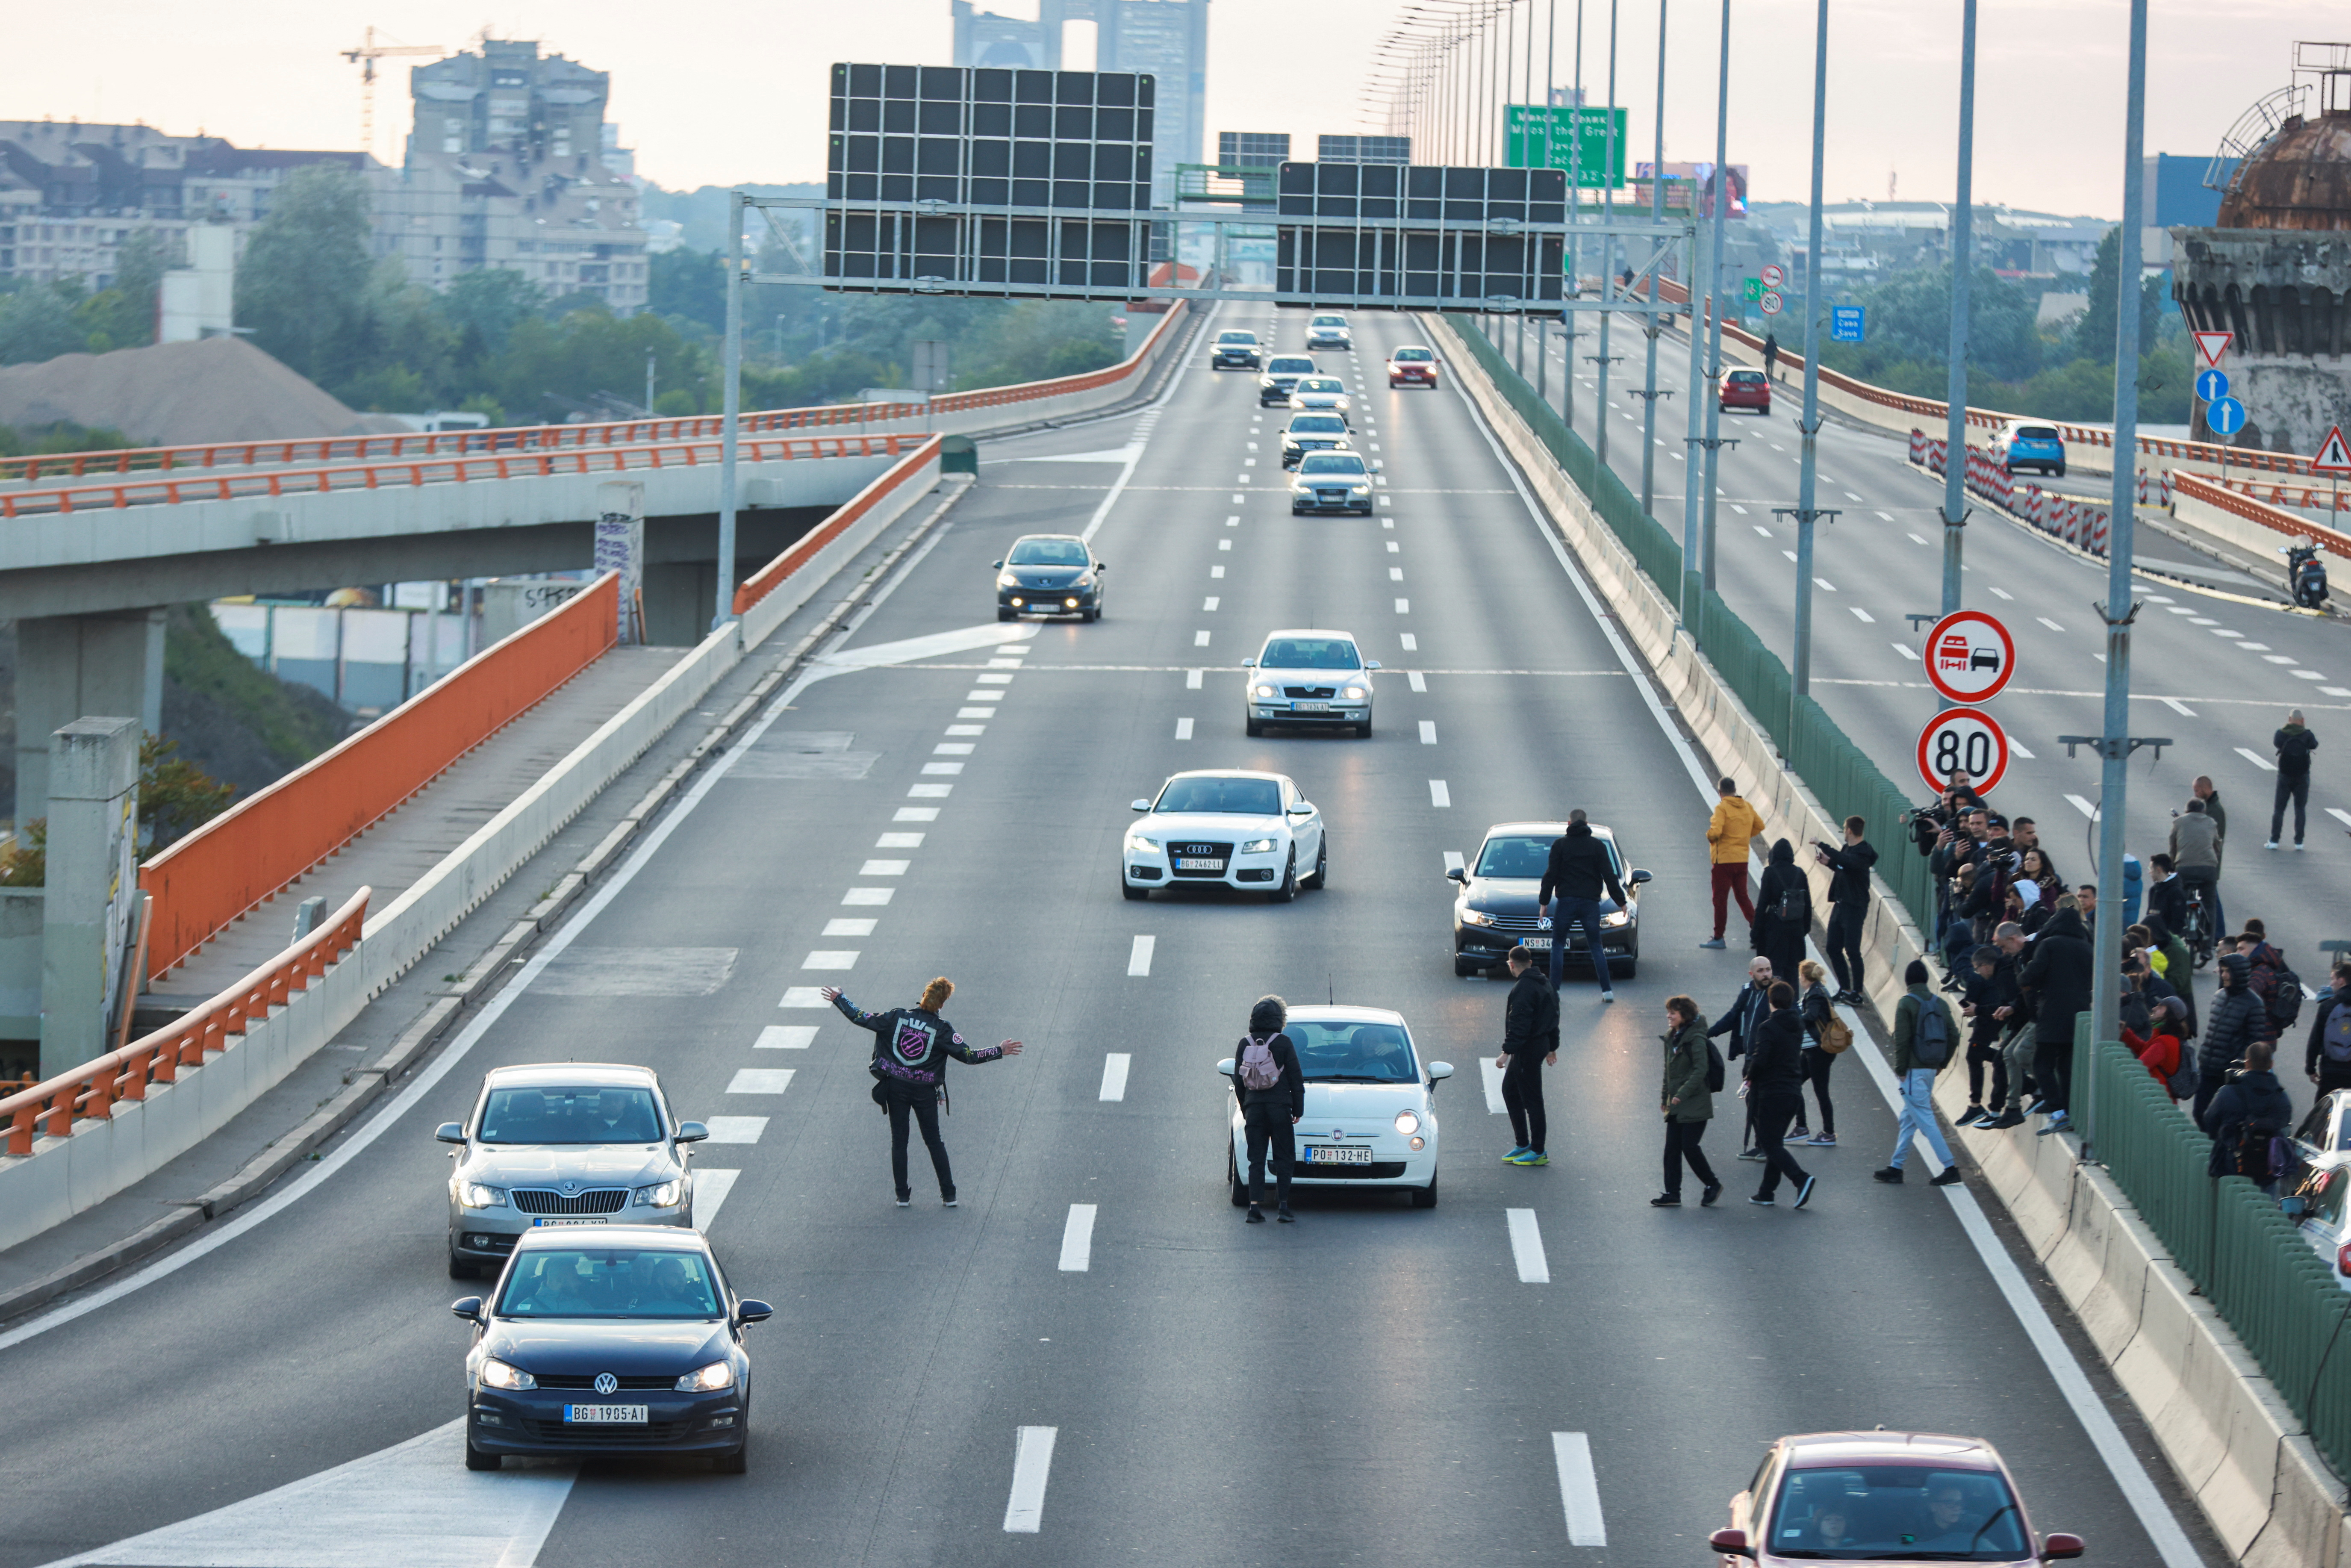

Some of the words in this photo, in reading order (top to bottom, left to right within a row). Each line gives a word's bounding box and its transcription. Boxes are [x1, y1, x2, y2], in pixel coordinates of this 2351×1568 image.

[1511, 124, 1545, 135] Mios
[1585, 125, 1619, 137] Gret
[1764, 297, 1779, 310] 80
[1936, 730, 1990, 777] 80
[1525, 939, 1535, 947] NS
[1314, 1149, 1326, 1160] PO
[597, 1374, 616, 1393] VW
[574, 1408, 588, 1420] BG
